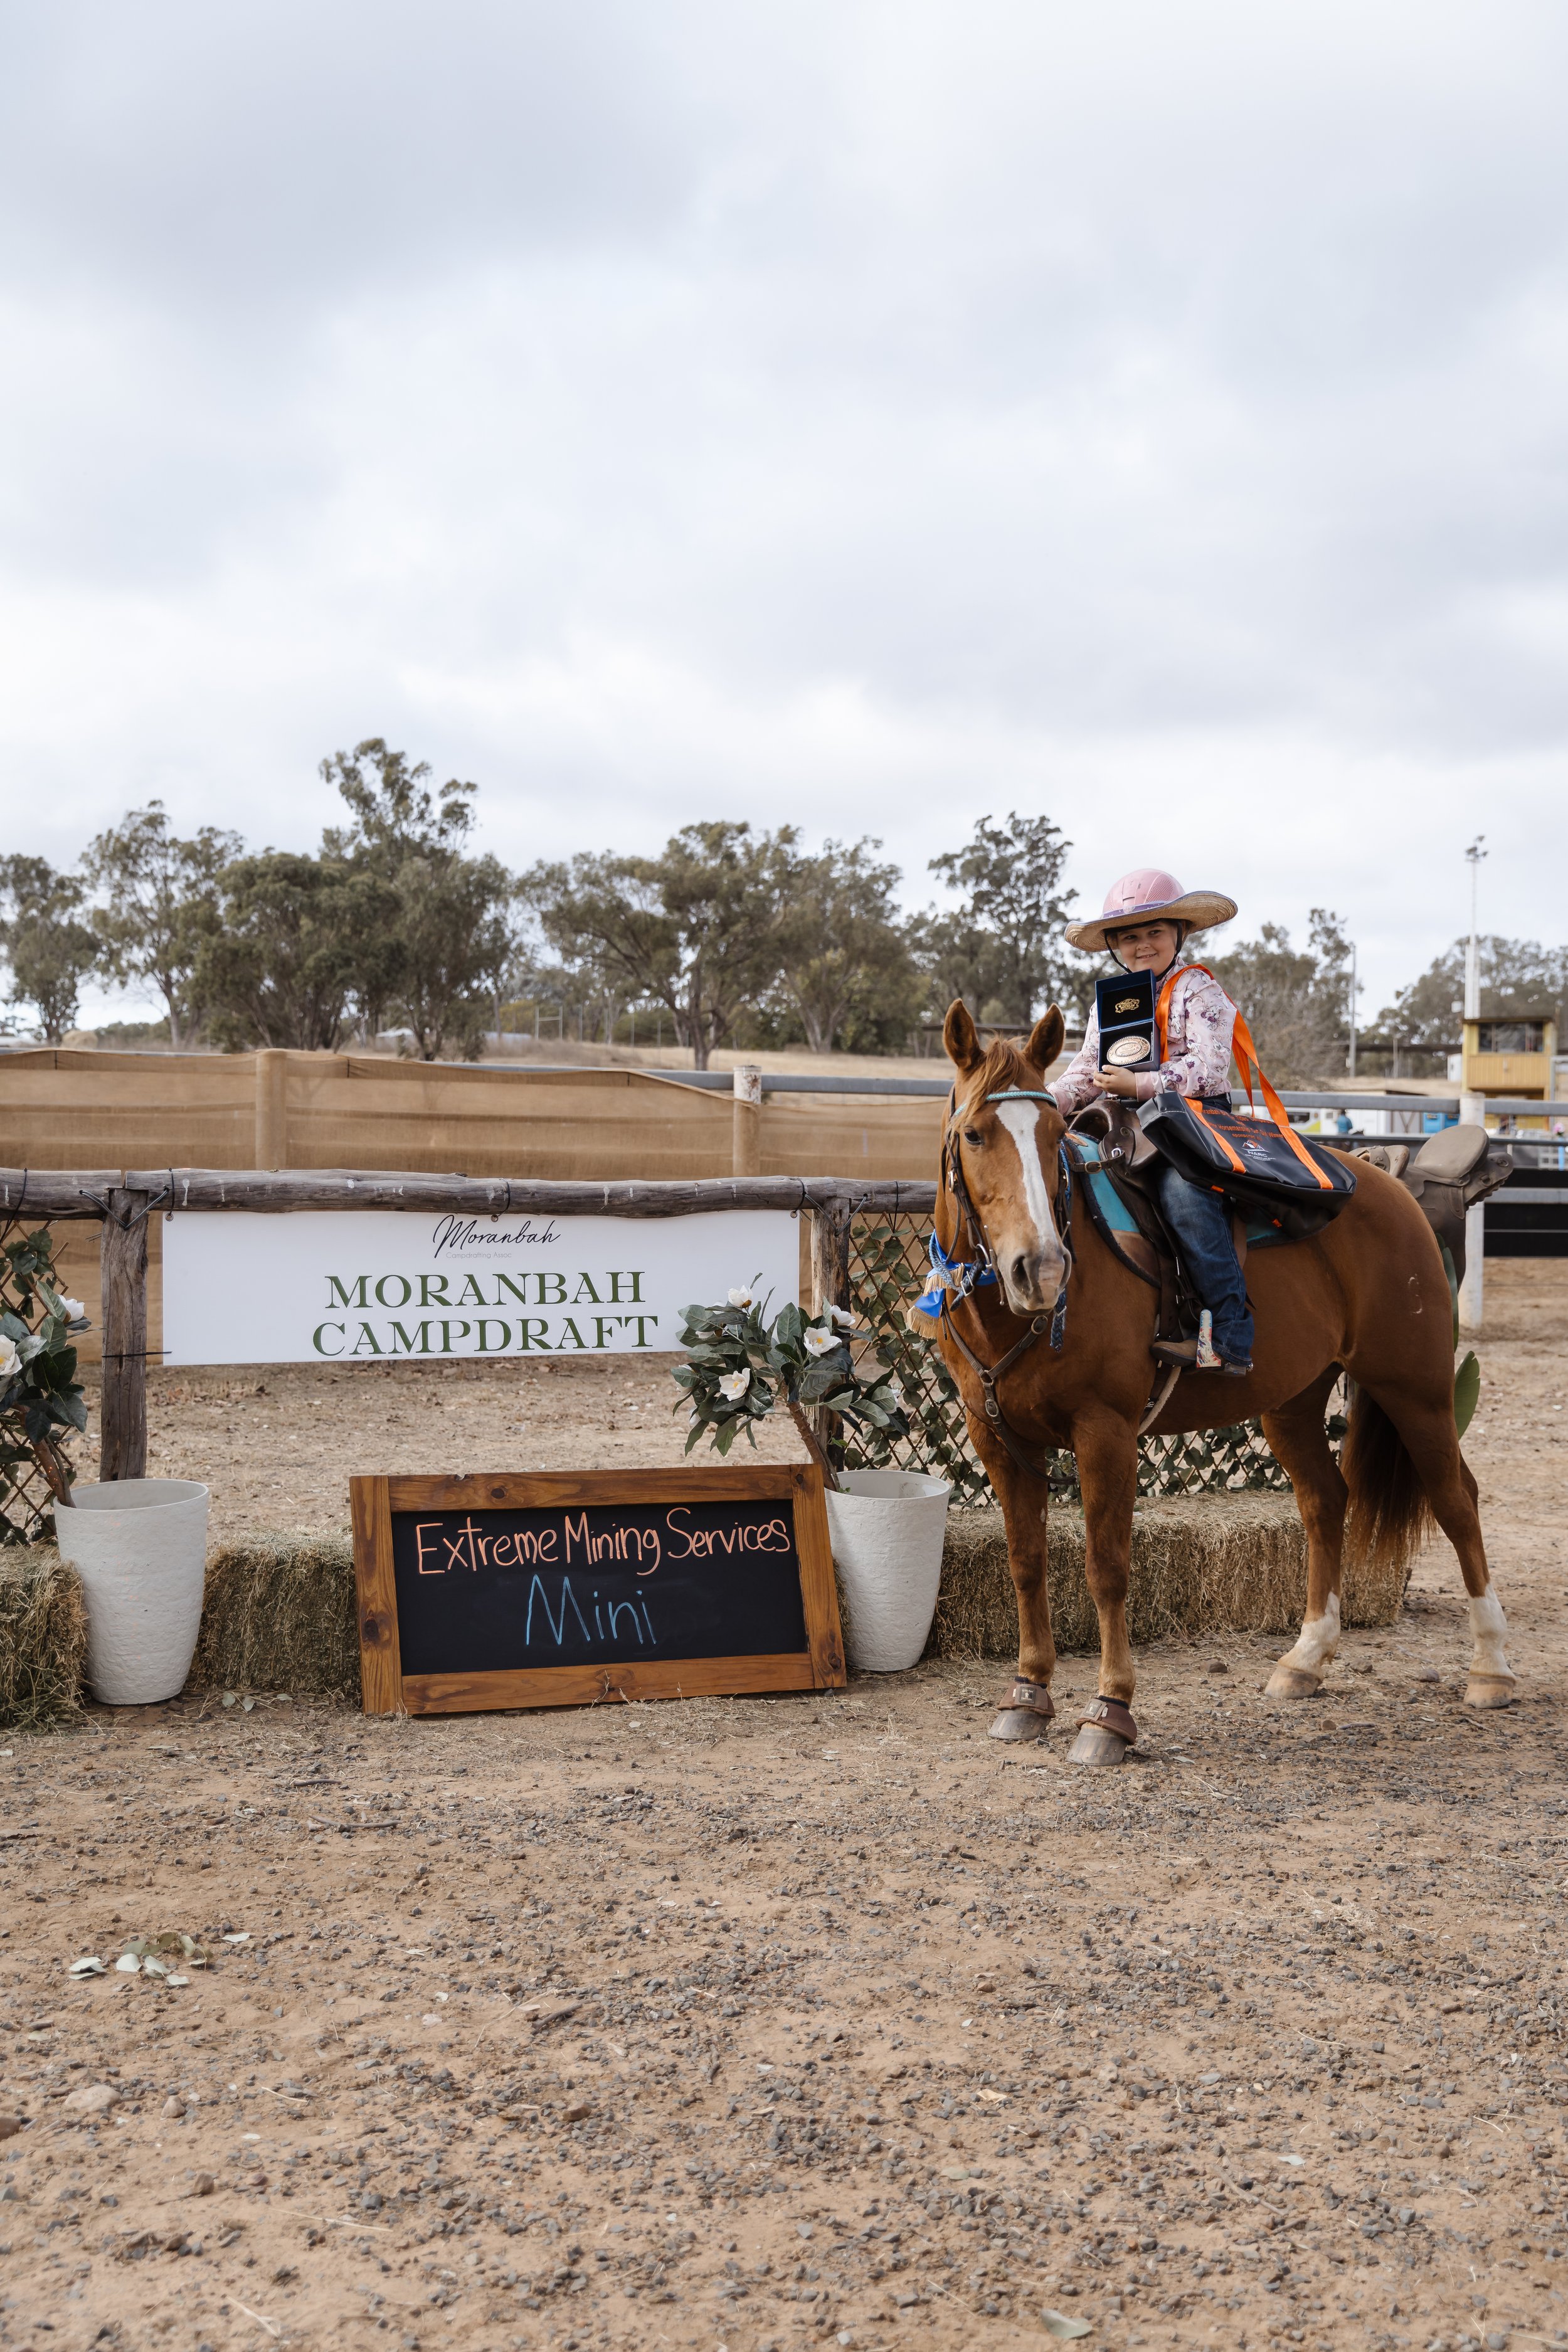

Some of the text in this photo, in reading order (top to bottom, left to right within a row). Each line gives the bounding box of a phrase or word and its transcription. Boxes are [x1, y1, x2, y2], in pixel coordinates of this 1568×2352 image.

[433, 1214, 561, 1259] Moranbah
[446, 1251, 492, 1259] Campdrafting
[324, 1271, 645, 1309] MORANBAH
[312, 1315, 659, 1357] CAMPDRAFT
[416, 1507, 791, 1576] Extreme Mining Services
[526, 1574, 657, 1646] Mini
